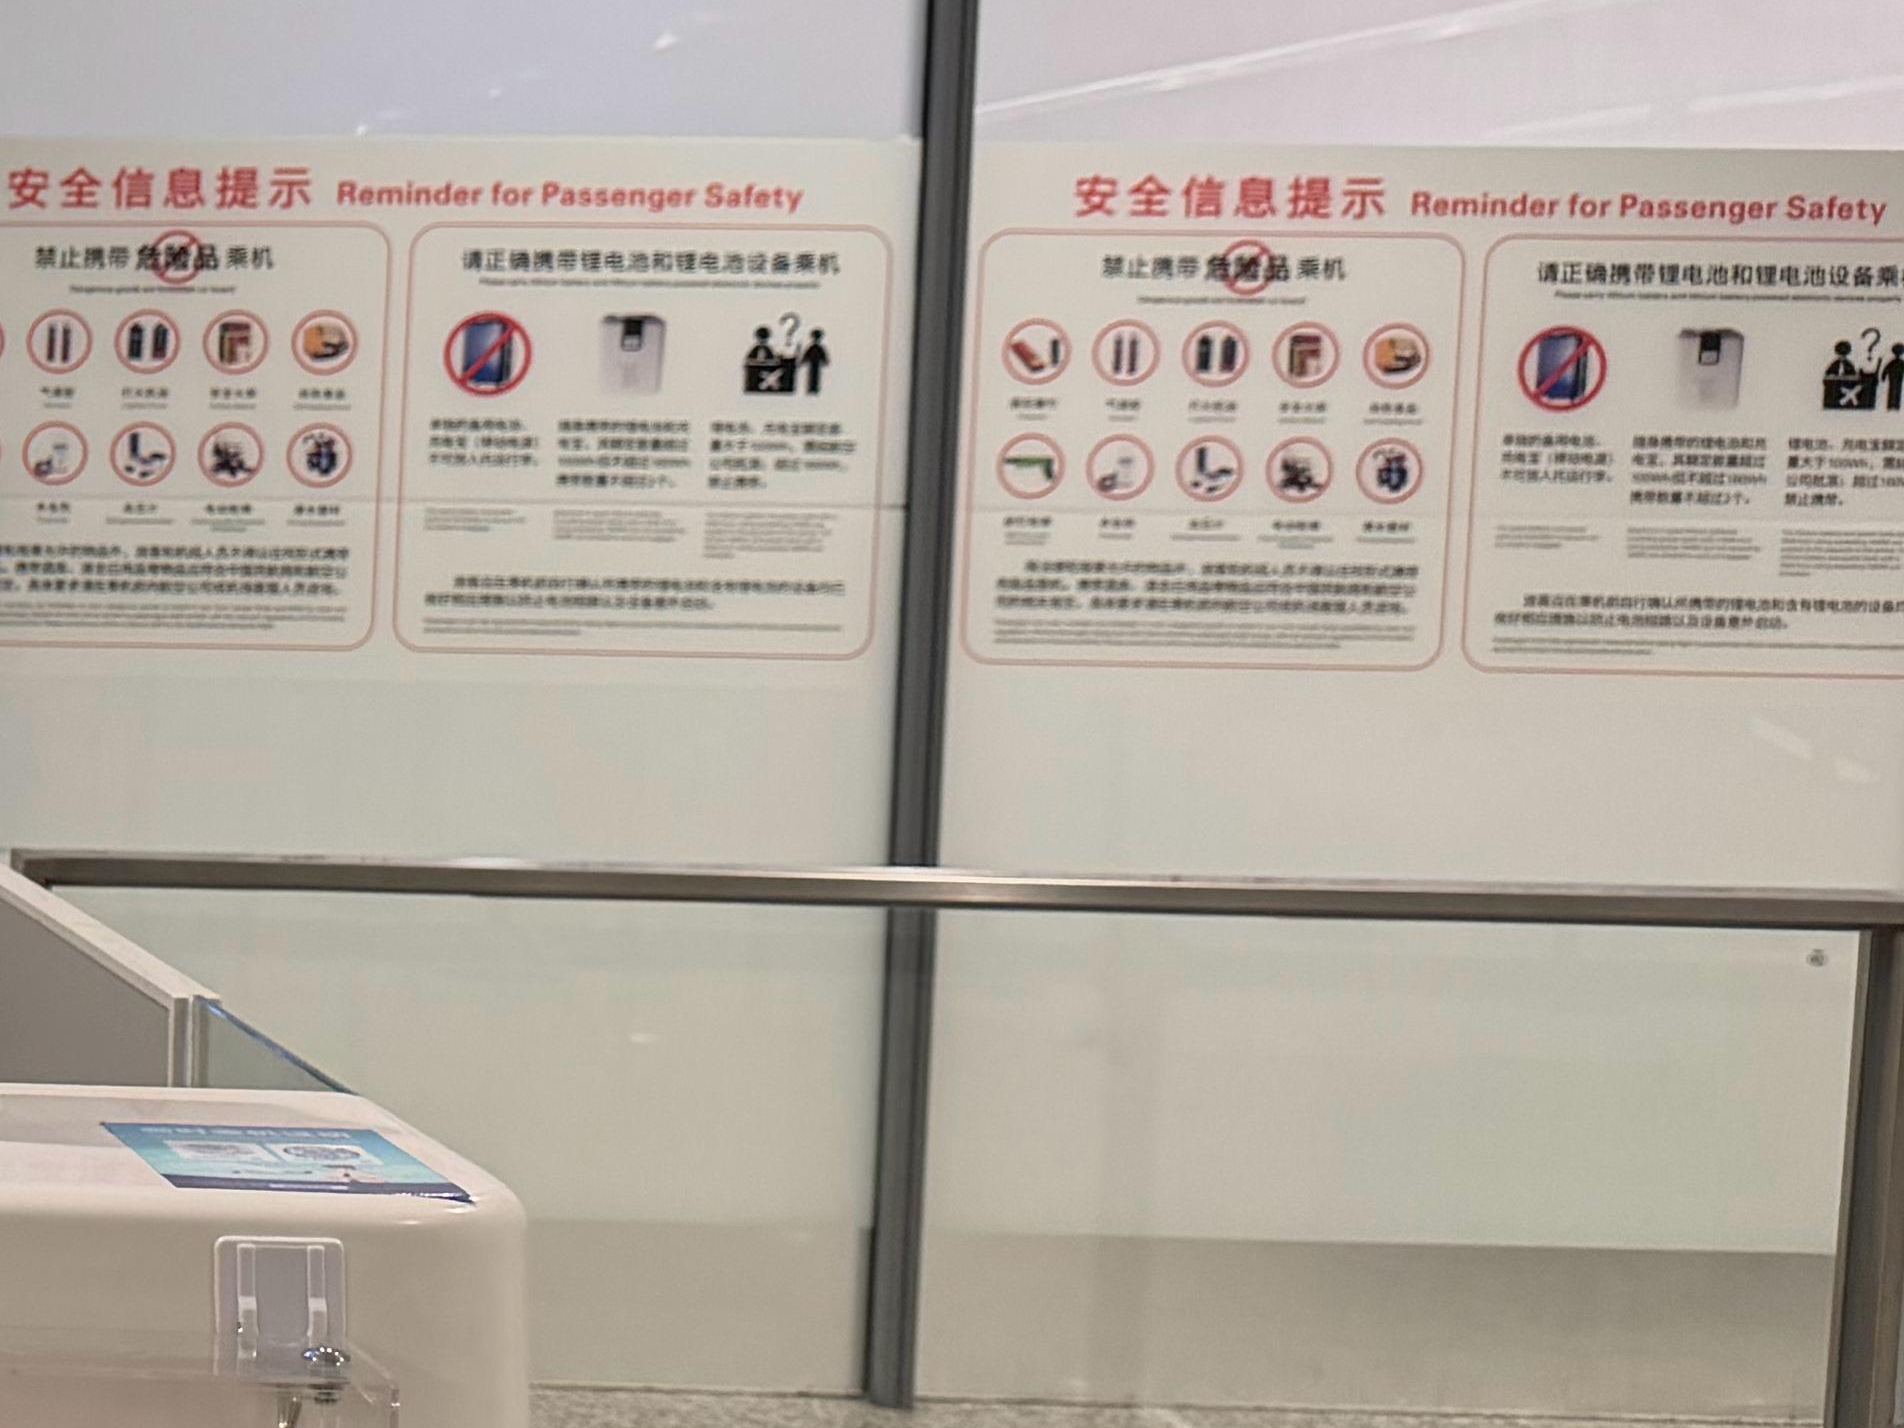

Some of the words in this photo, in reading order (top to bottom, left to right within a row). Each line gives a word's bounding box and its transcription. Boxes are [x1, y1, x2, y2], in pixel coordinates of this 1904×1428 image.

[7, 167, 311, 210] 安全信息提示
[336, 180, 483, 207] Reminder
[491, 181, 533, 207] for
[541, 182, 697, 213] Passenger
[704, 182, 804, 214] Safety
[1075, 175, 1386, 220] 安全信息提示
[1411, 191, 1560, 218] Reminder
[1568, 192, 1612, 218] for
[1619, 193, 1779, 225] Passenger
[1786, 195, 1887, 227] Safety
[1537, 262, 1904, 290] 请正确携带锂电池和锂电池设备乘
